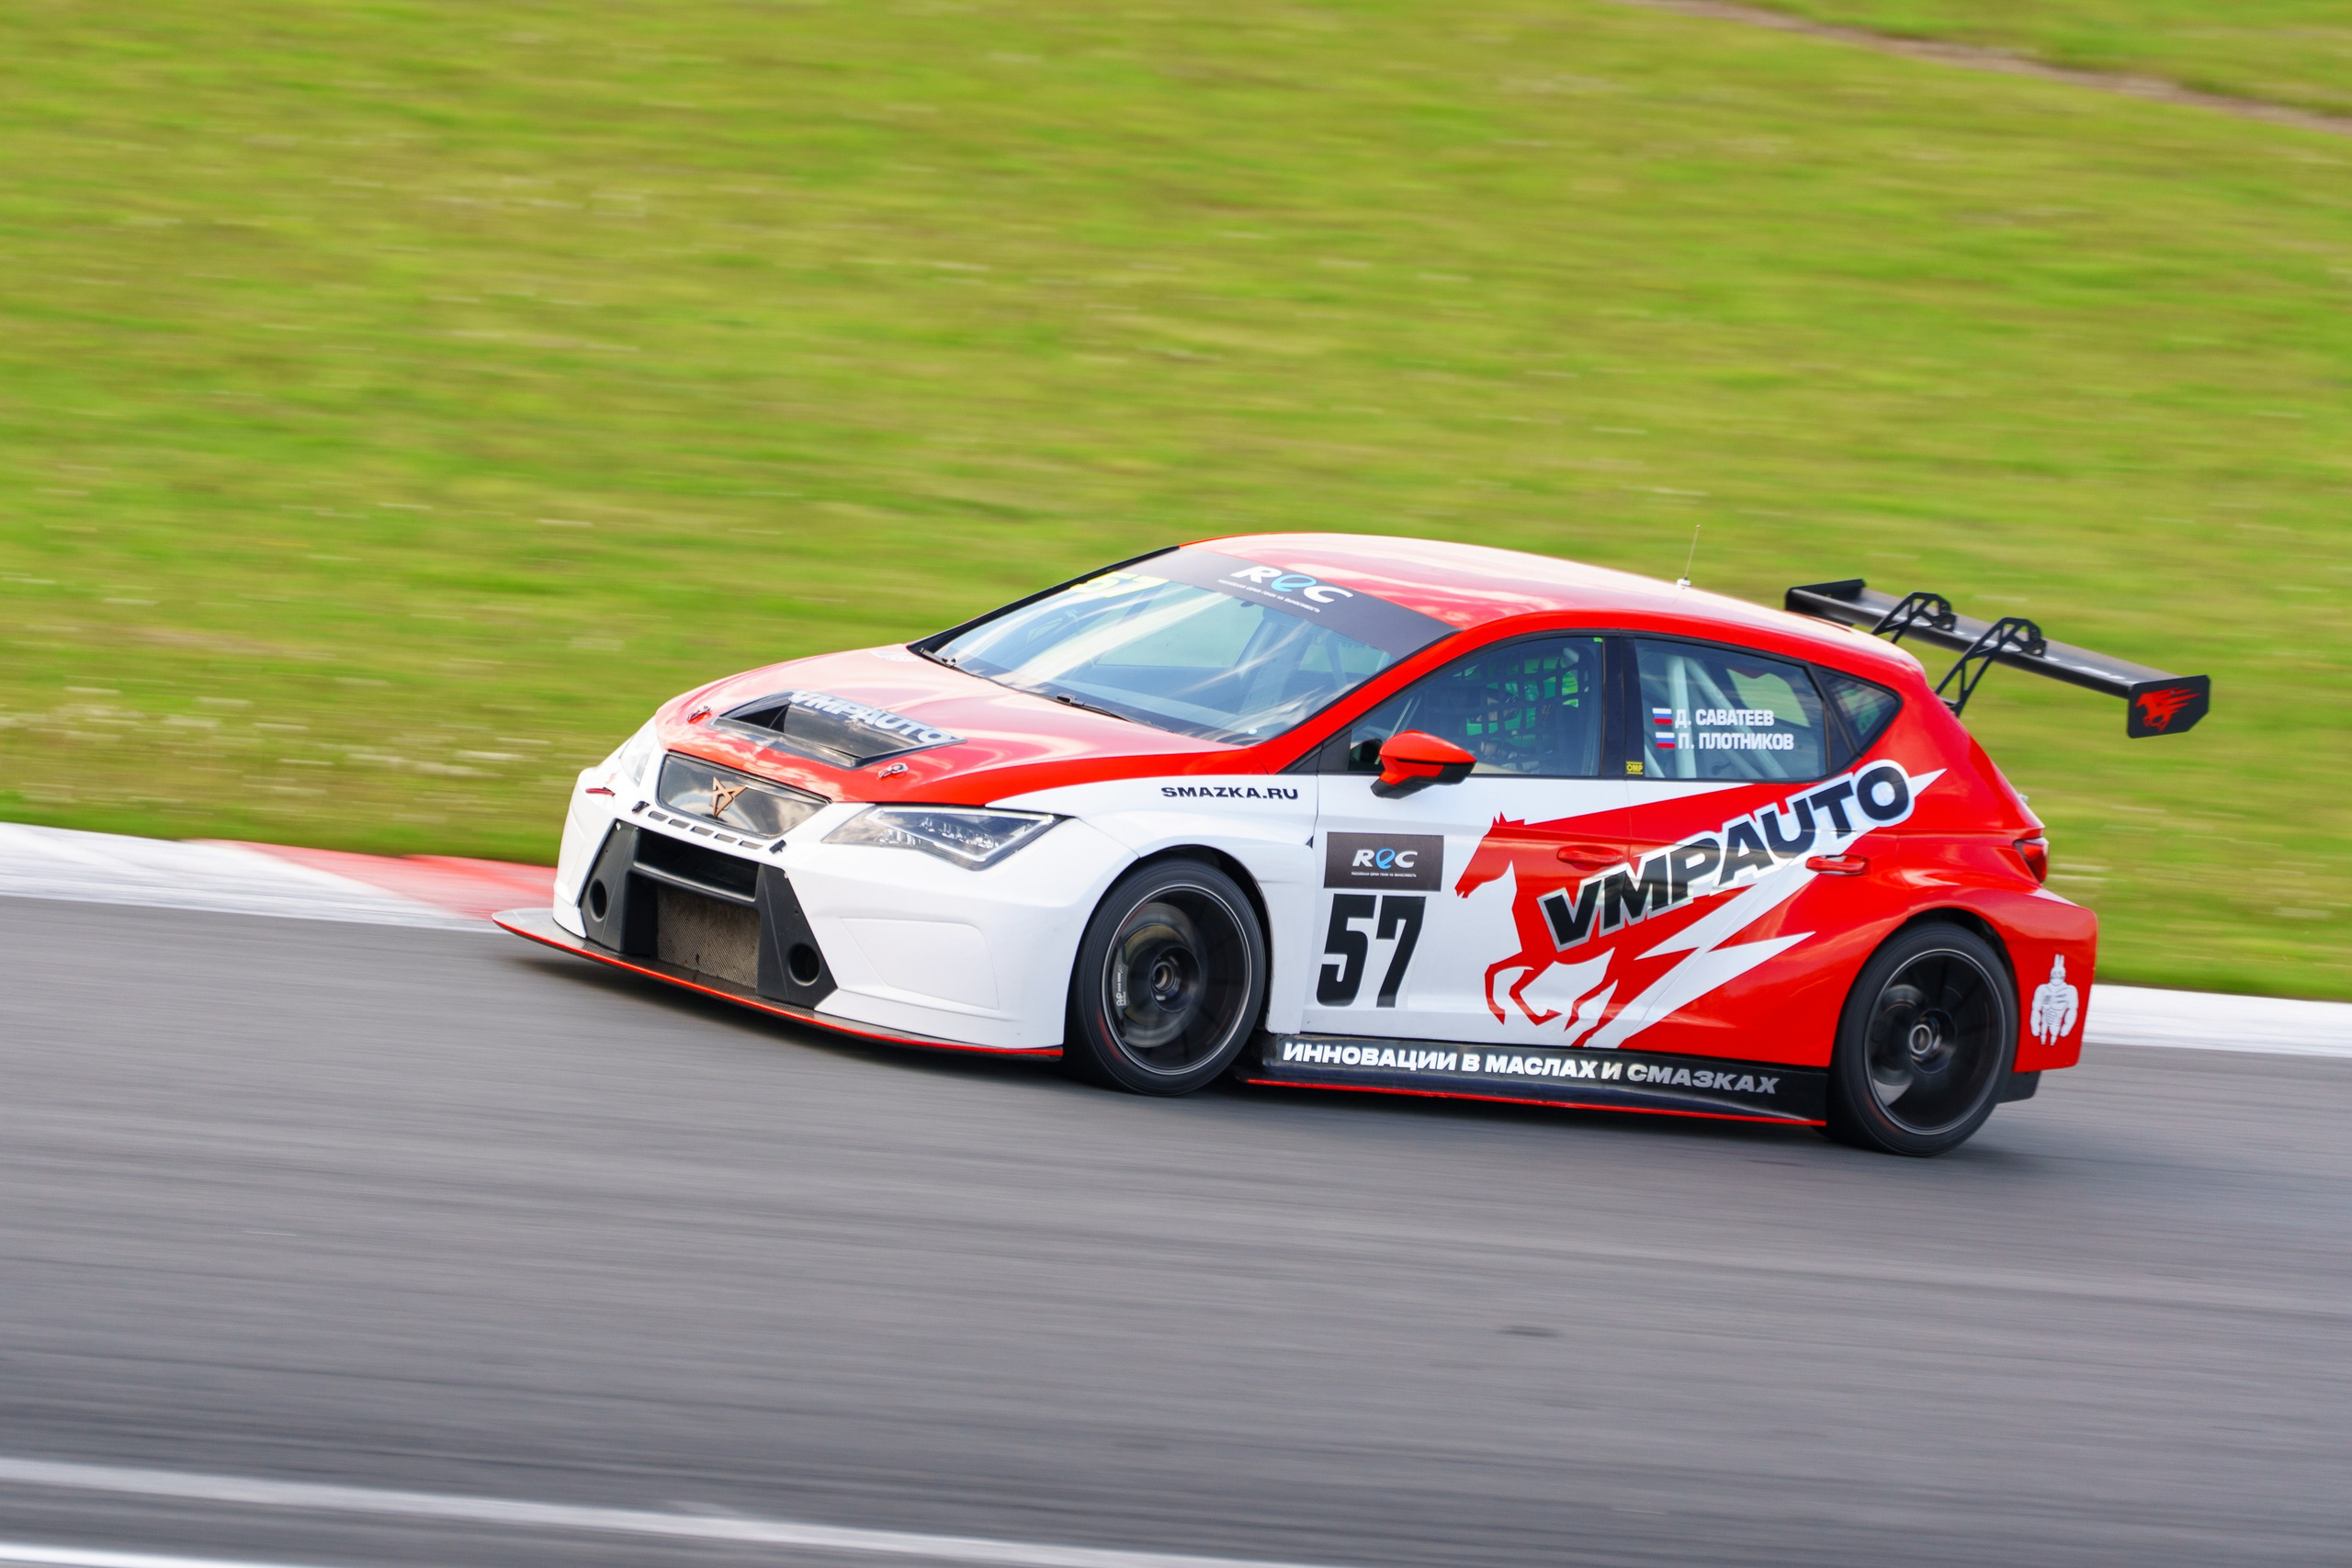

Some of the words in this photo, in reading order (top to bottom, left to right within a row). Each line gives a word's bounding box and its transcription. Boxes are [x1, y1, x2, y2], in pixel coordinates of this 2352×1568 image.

[787, 690, 953, 743] VMPAUTO
[1674, 709, 1692, 728] Д.
[1696, 709, 1775, 727] САВАТЕЕВ
[1678, 733, 1695, 750] П.
[1699, 733, 1794, 750] ПЛОТНИКОВ
[1626, 763, 1644, 773] OMP
[1160, 786, 1299, 800] SMAZKA.RU
[1541, 762, 1912, 950] VMPAUTO
[1316, 893, 1427, 1010] 57
[1283, 1043, 1458, 1072] ИННОВАЦИИ
[1462, 1054, 1480, 1072] В
[1485, 1055, 1597, 1078] МАСЛАХ
[1601, 1063, 1623, 1080] И
[1626, 1064, 1780, 1094] СМАЗКАХ
